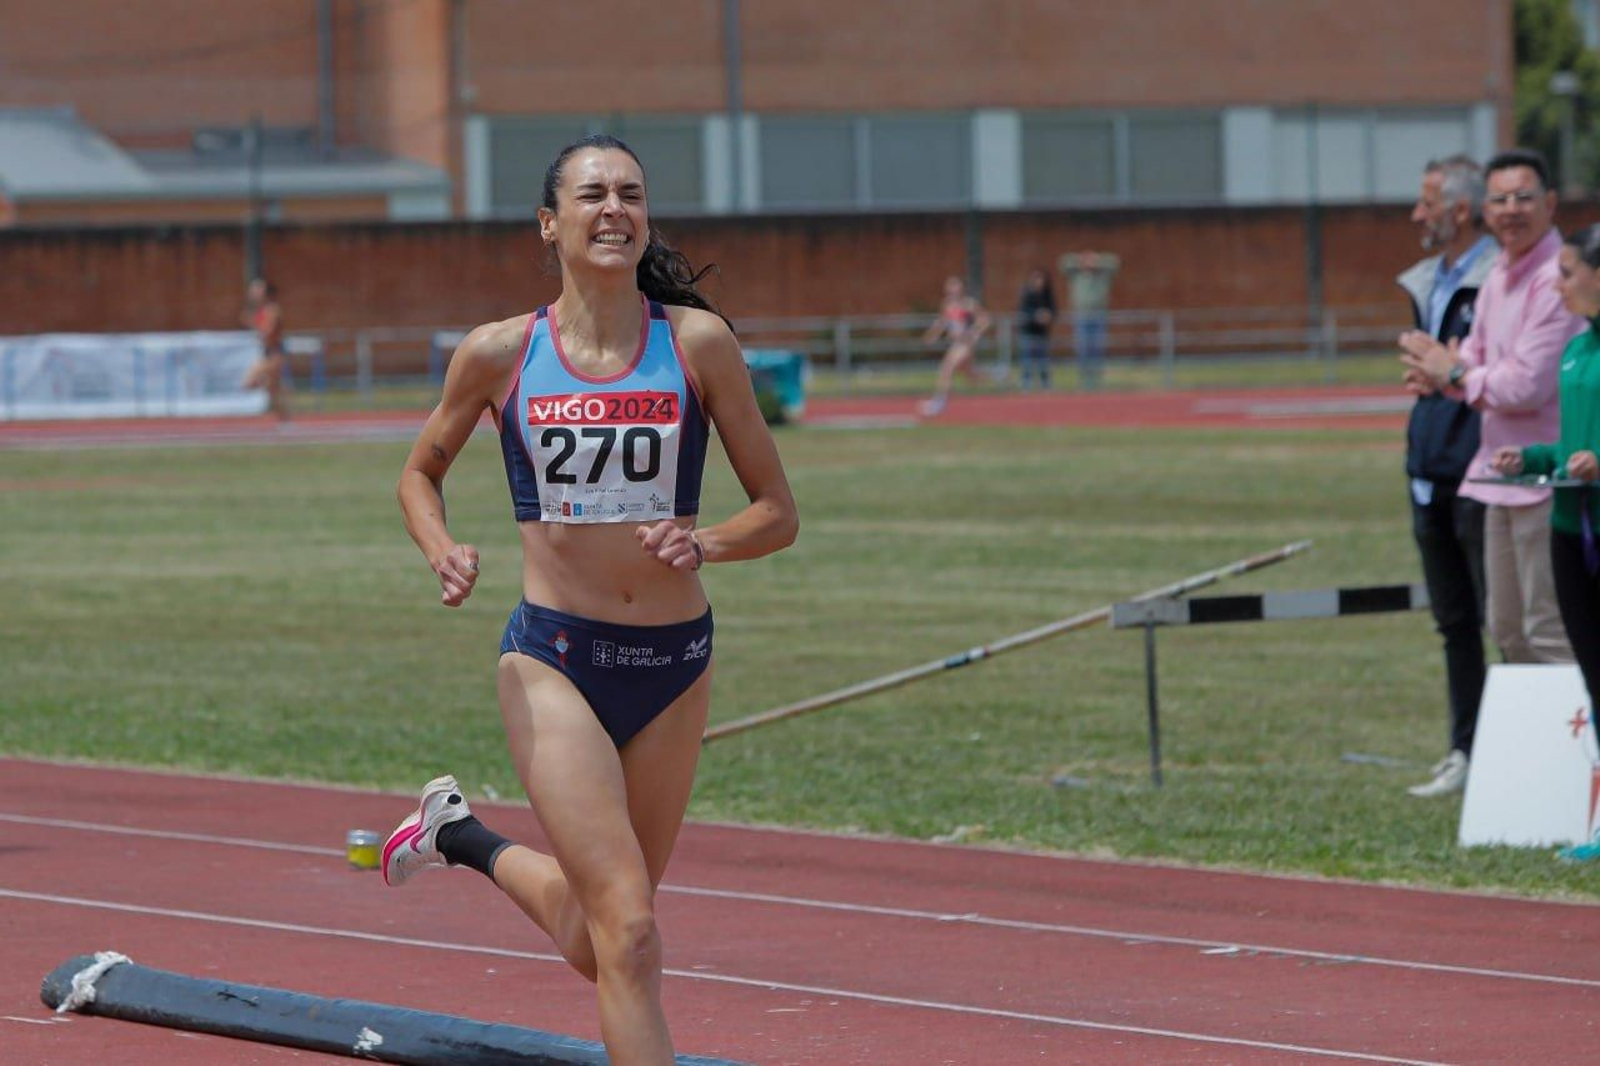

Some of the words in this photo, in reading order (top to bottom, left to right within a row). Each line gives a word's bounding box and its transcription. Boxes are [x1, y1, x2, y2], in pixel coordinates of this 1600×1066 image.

[533, 398, 674, 421] VIGO2024
[540, 427, 662, 484] 270
[618, 646, 653, 656] XUNTA
[616, 655, 629, 665] DE
[631, 655, 672, 666] GALICIA
